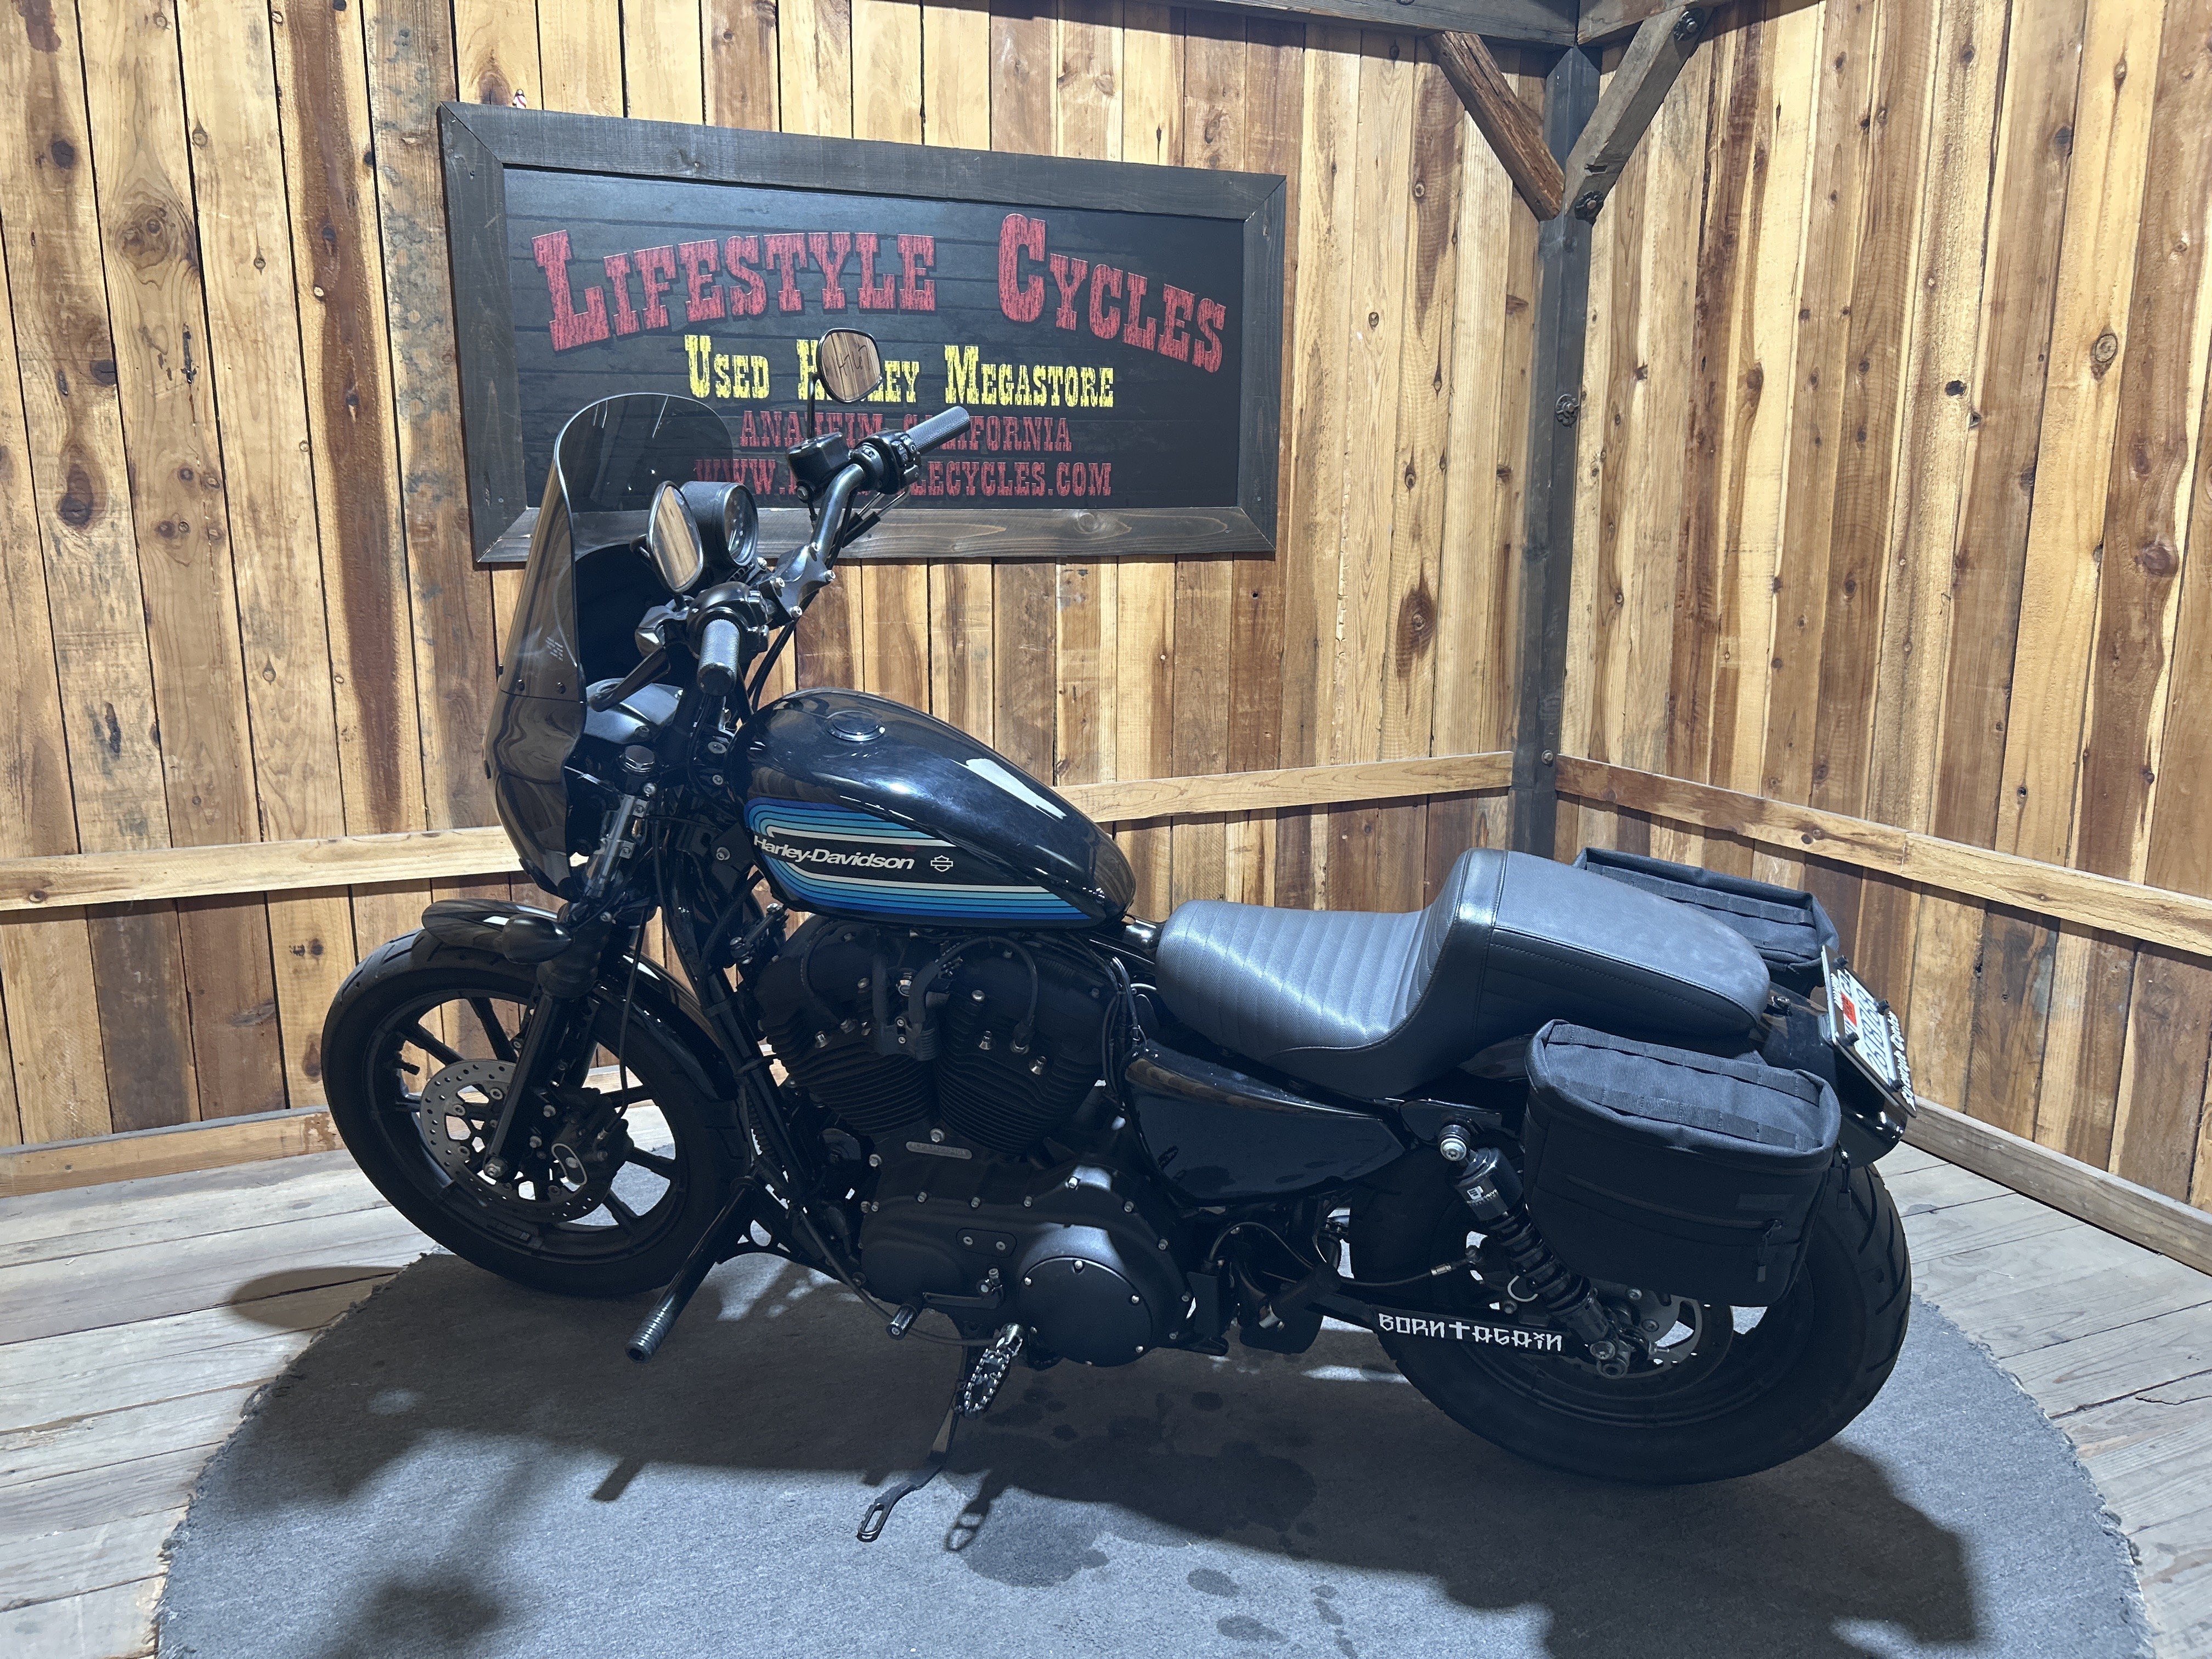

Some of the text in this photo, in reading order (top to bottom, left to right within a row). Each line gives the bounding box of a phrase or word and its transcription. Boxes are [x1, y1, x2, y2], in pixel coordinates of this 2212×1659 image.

[531, 213, 1226, 373] LIFESTYLE CYCLES
[684, 335, 770, 399] USED
[944, 345, 1114, 408] MEGASTORE
[754, 834, 915, 870] Harley-Davidson
